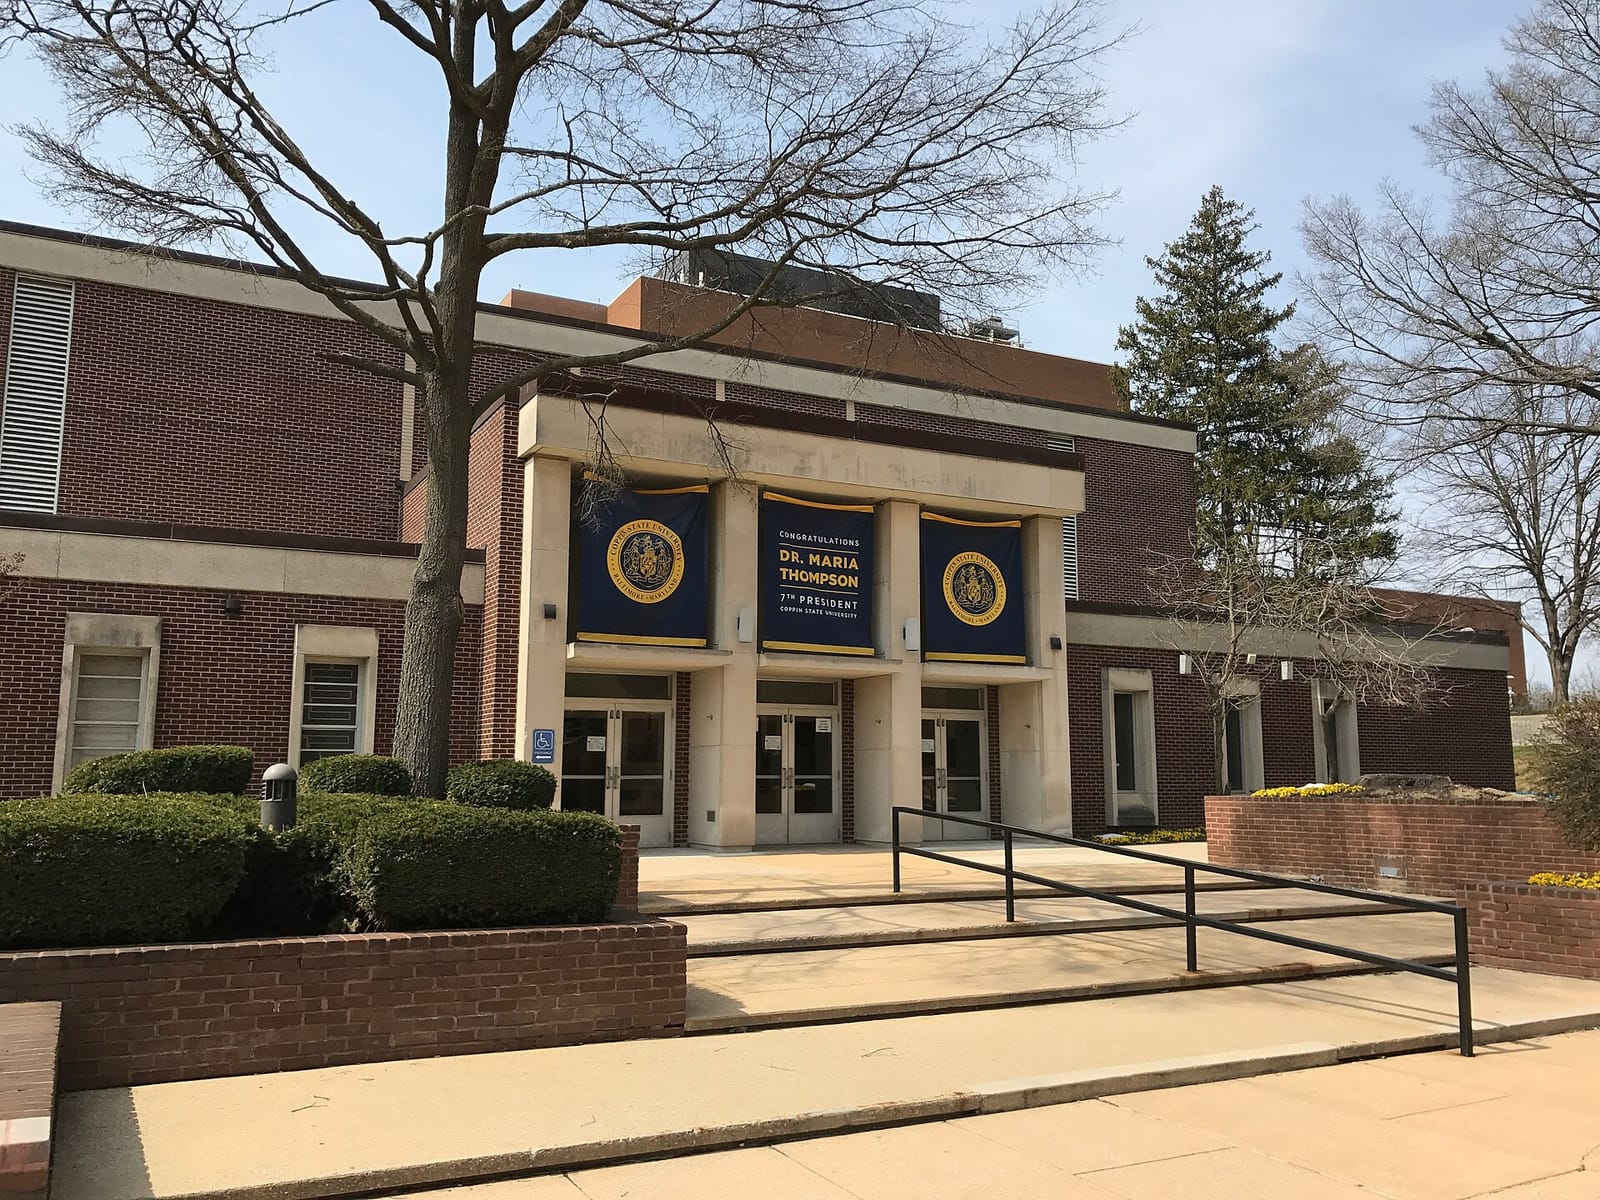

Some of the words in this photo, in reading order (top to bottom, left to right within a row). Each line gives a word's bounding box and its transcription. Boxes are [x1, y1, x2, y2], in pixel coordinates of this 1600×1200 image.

[627, 522, 651, 531] STATE
[779, 530, 860, 547] CONGRATULATIONS
[780, 549, 804, 564] DR.
[809, 553, 859, 570] MARIA
[779, 567, 859, 588] THOMPSON
[780, 593, 796, 602] 7TH
[800, 595, 858, 610] PRESIDENT
[825, 610, 858, 619] UNIVERSITY
